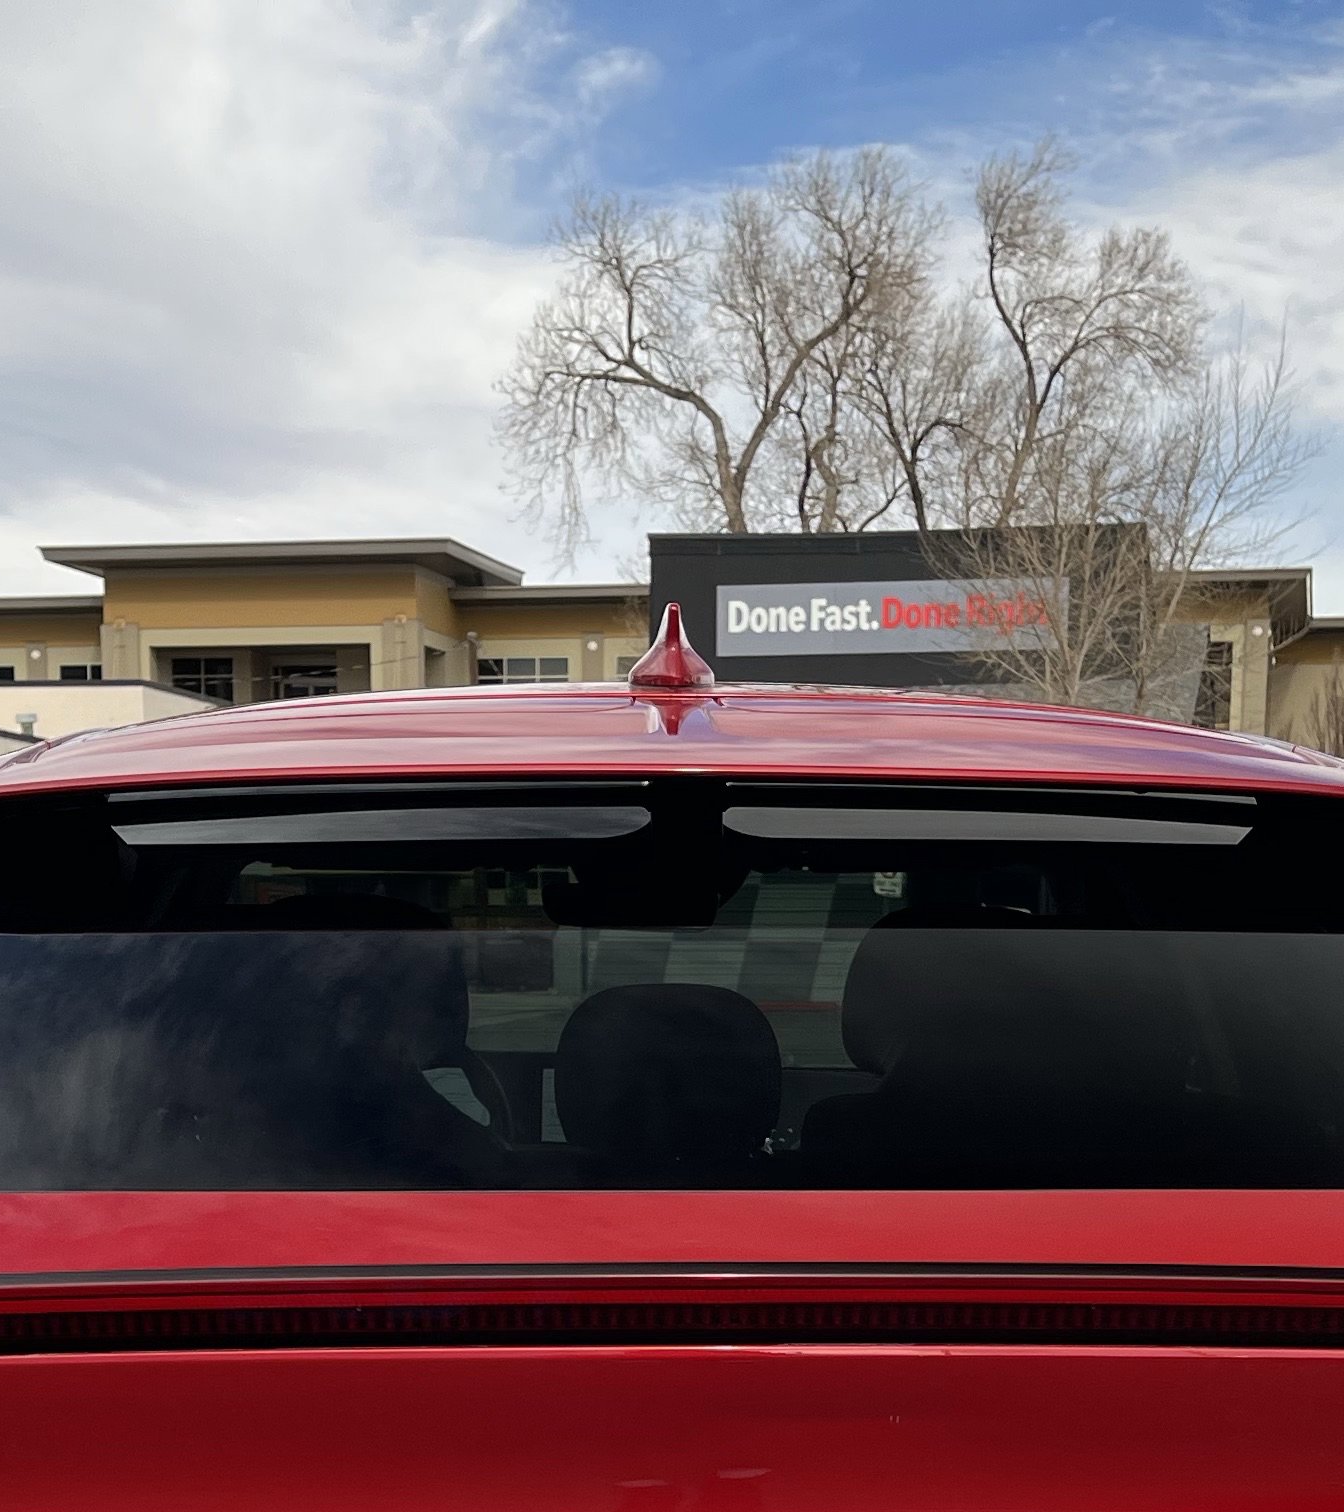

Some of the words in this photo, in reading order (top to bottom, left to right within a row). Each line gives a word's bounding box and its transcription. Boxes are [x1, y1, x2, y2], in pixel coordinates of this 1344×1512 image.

[727, 600, 806, 633] Done
[810, 597, 880, 632] Fast.
[881, 597, 960, 630] Done
